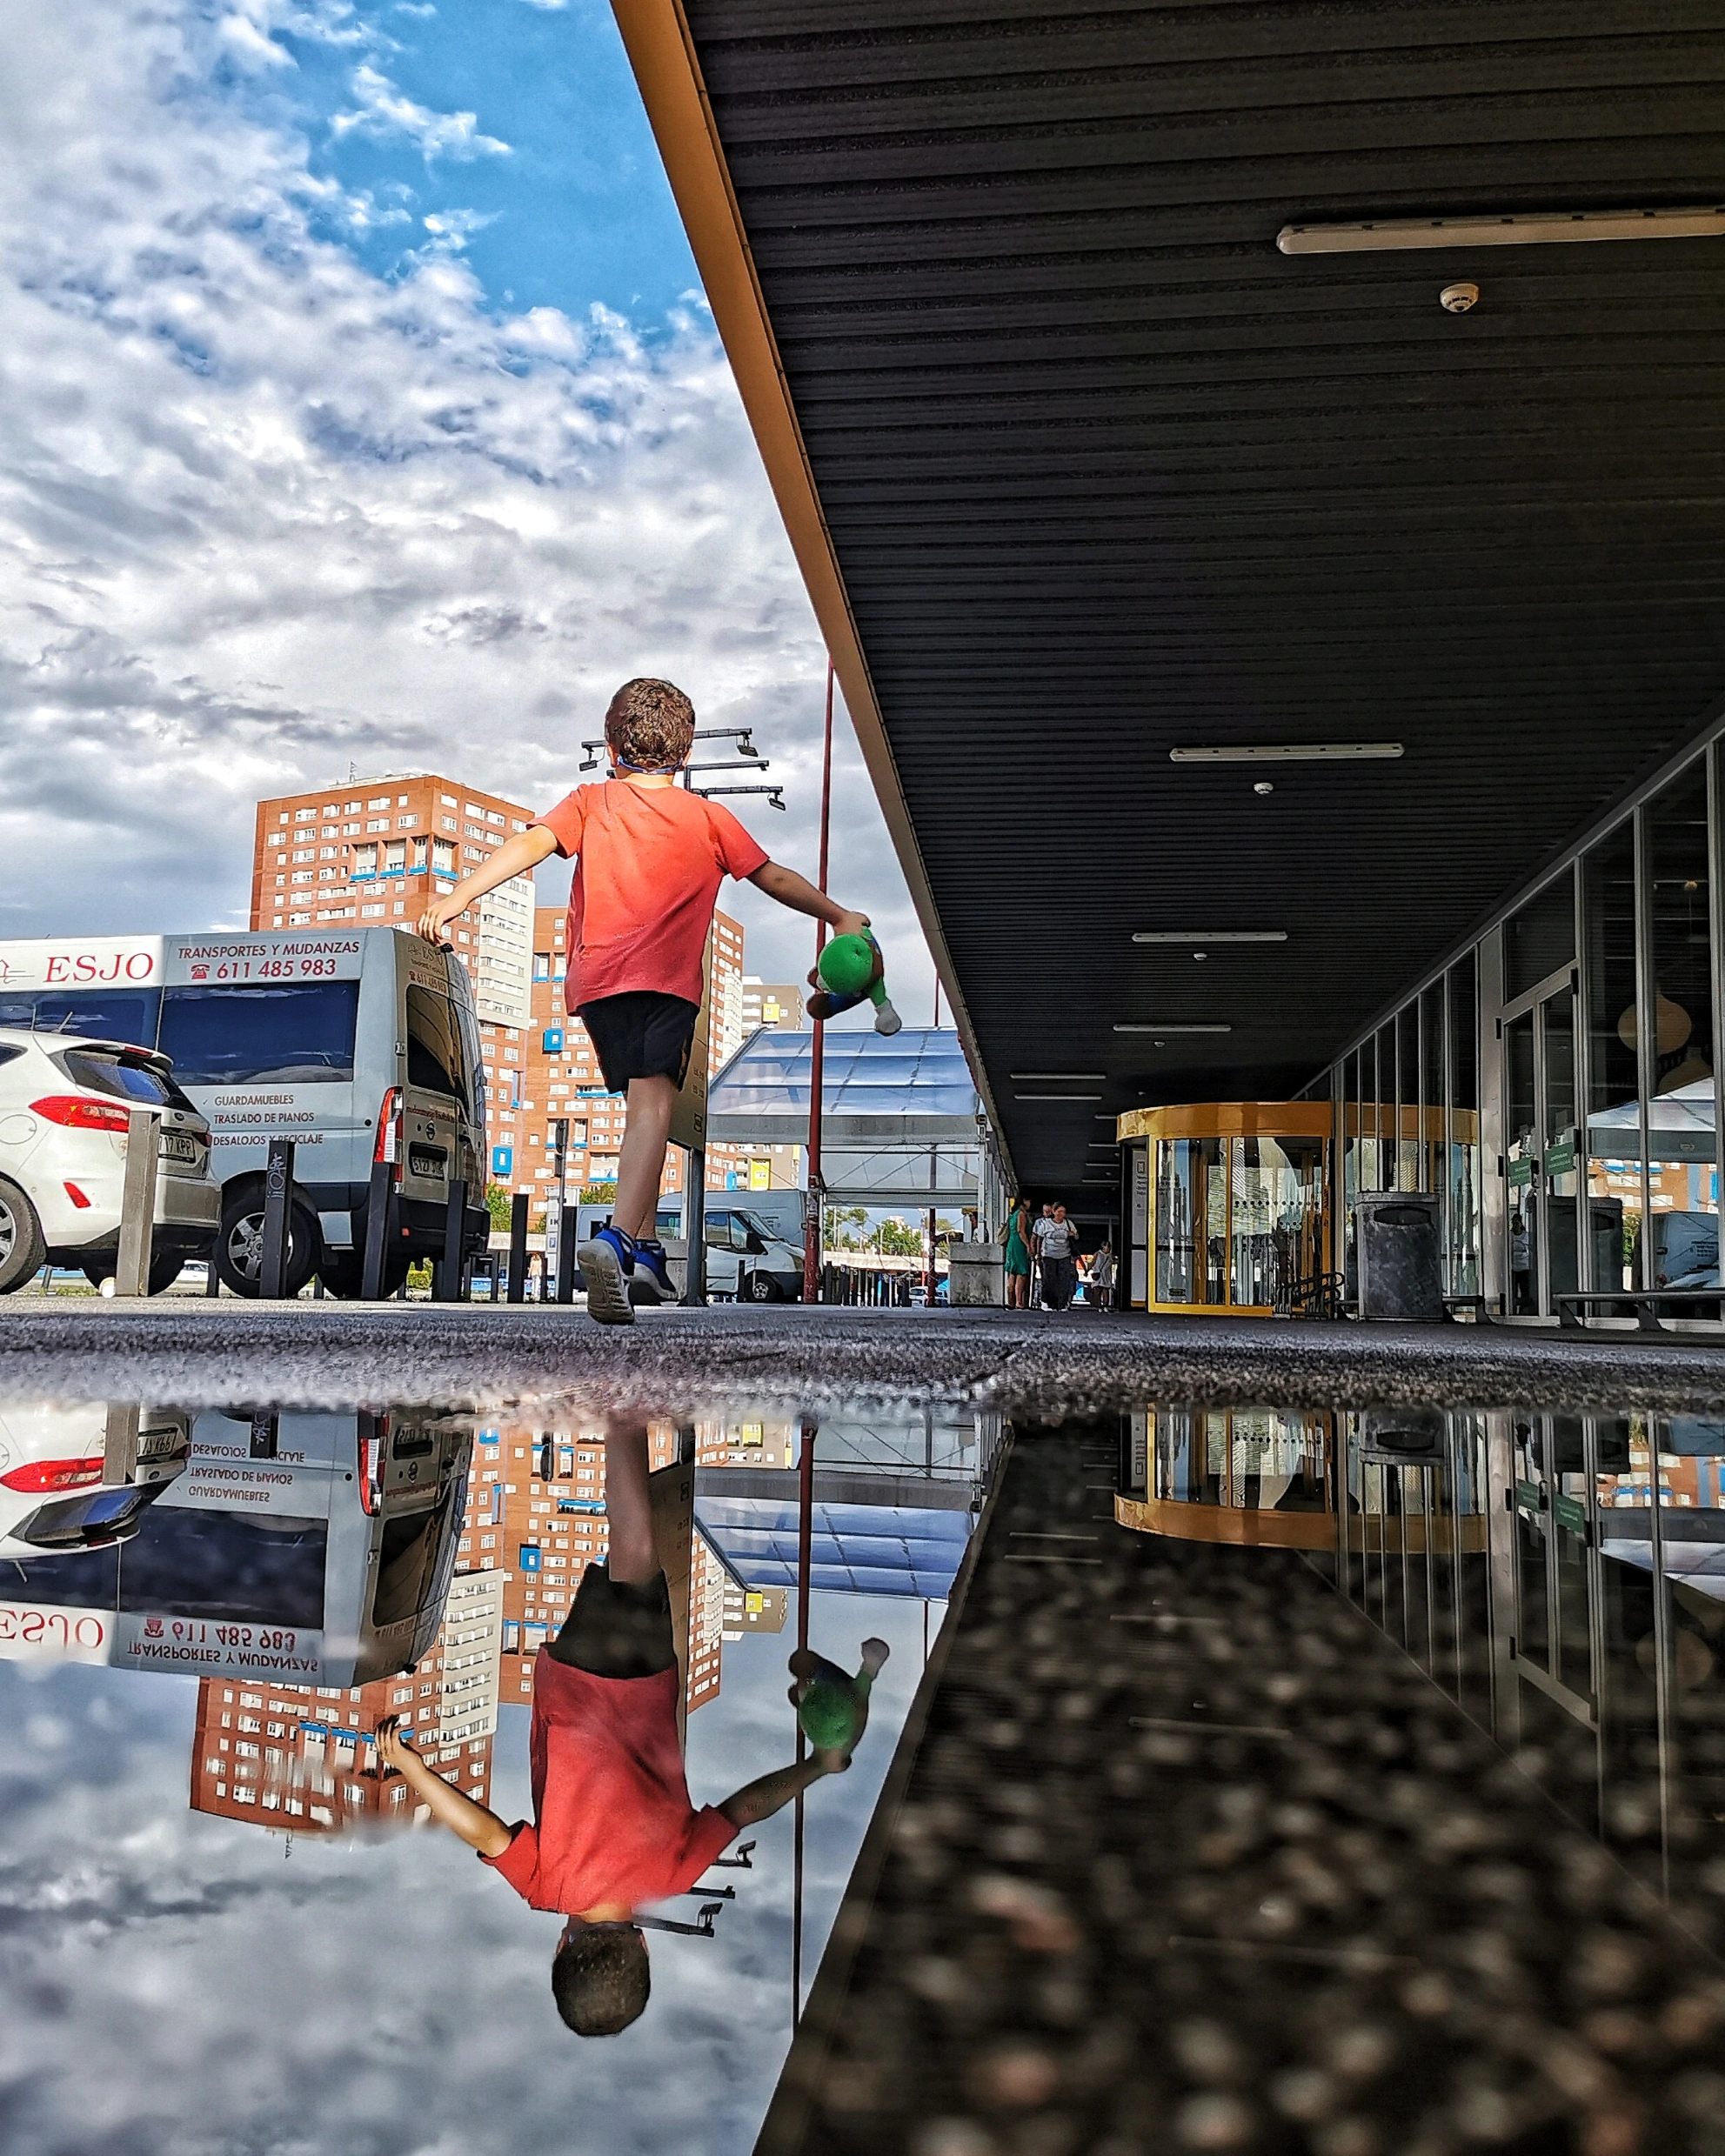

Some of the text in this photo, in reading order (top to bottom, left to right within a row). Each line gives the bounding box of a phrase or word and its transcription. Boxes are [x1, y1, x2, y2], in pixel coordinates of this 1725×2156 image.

[178, 941, 359, 958] TRANSPORTES Y MUDANZAS
[43, 952, 153, 983] ESJO
[217, 958, 336, 979] 611 485 983
[214, 1094, 294, 1106] GUARDAMUEBLES
[213, 1112, 314, 1125] TRASLADO DE PIANOS
[213, 1135, 266, 1146] DESALOJOS
